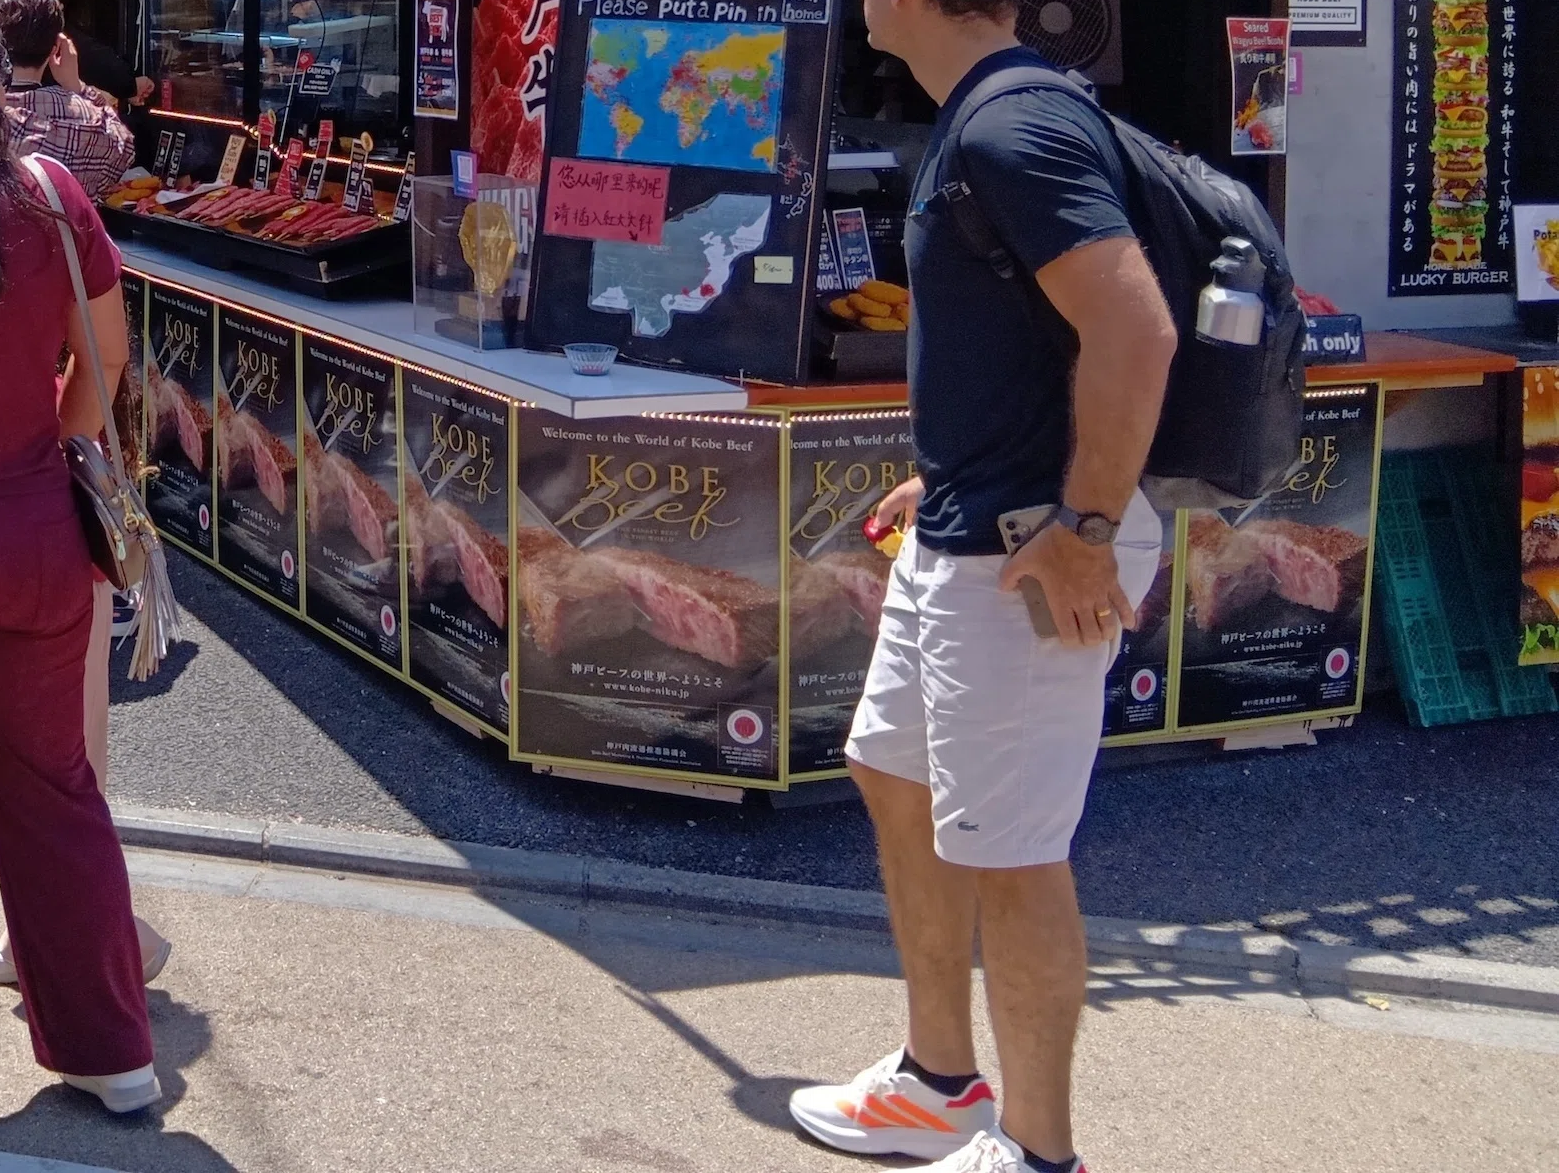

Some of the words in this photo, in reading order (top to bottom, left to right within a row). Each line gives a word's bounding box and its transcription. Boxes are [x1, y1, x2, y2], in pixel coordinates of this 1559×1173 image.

[699, 1, 710, 18] a
[757, 3, 777, 22] in
[785, 3, 824, 20] home
[1243, 21, 1269, 33] Seared
[1400, 273, 1447, 287] LUCKY
[1452, 270, 1509, 285] BURGER
[1423, 262, 1454, 272] HOME
[165, 311, 199, 348] KOBE
[1322, 331, 1361, 355] only
[237, 339, 279, 380] KOBE
[325, 372, 374, 417] KOBE
[1305, 410, 1315, 421] of
[1317, 409, 1340, 421] Kobe
[1341, 407, 1361, 419] Beef
[431, 412, 490, 465] KOBE
[541, 426, 593, 442] Welcome
[596, 432, 609, 443] to
[612, 432, 630, 444] the
[634, 433, 669, 447] World
[673, 436, 687, 448] of
[691, 437, 722, 450] Kobe
[726, 440, 754, 453] Beef
[790, 438, 819, 450] lcome
[821, 437, 832, 448] to
[835, 436, 850, 447] the
[852, 434, 882, 446] World
[884, 433, 896, 444] of
[898, 433, 913, 444] Ko
[1301, 435, 1337, 464] BE
[419, 438, 501, 504] Beef
[585, 454, 720, 497] KOBE
[1286, 452, 1347, 504] ef
[561, 480, 741, 541] Beef
[570, 662, 723, 688] 神戸ビーフの世界へようこそ
[603, 681, 690, 699] www.kobe-niku.jp
